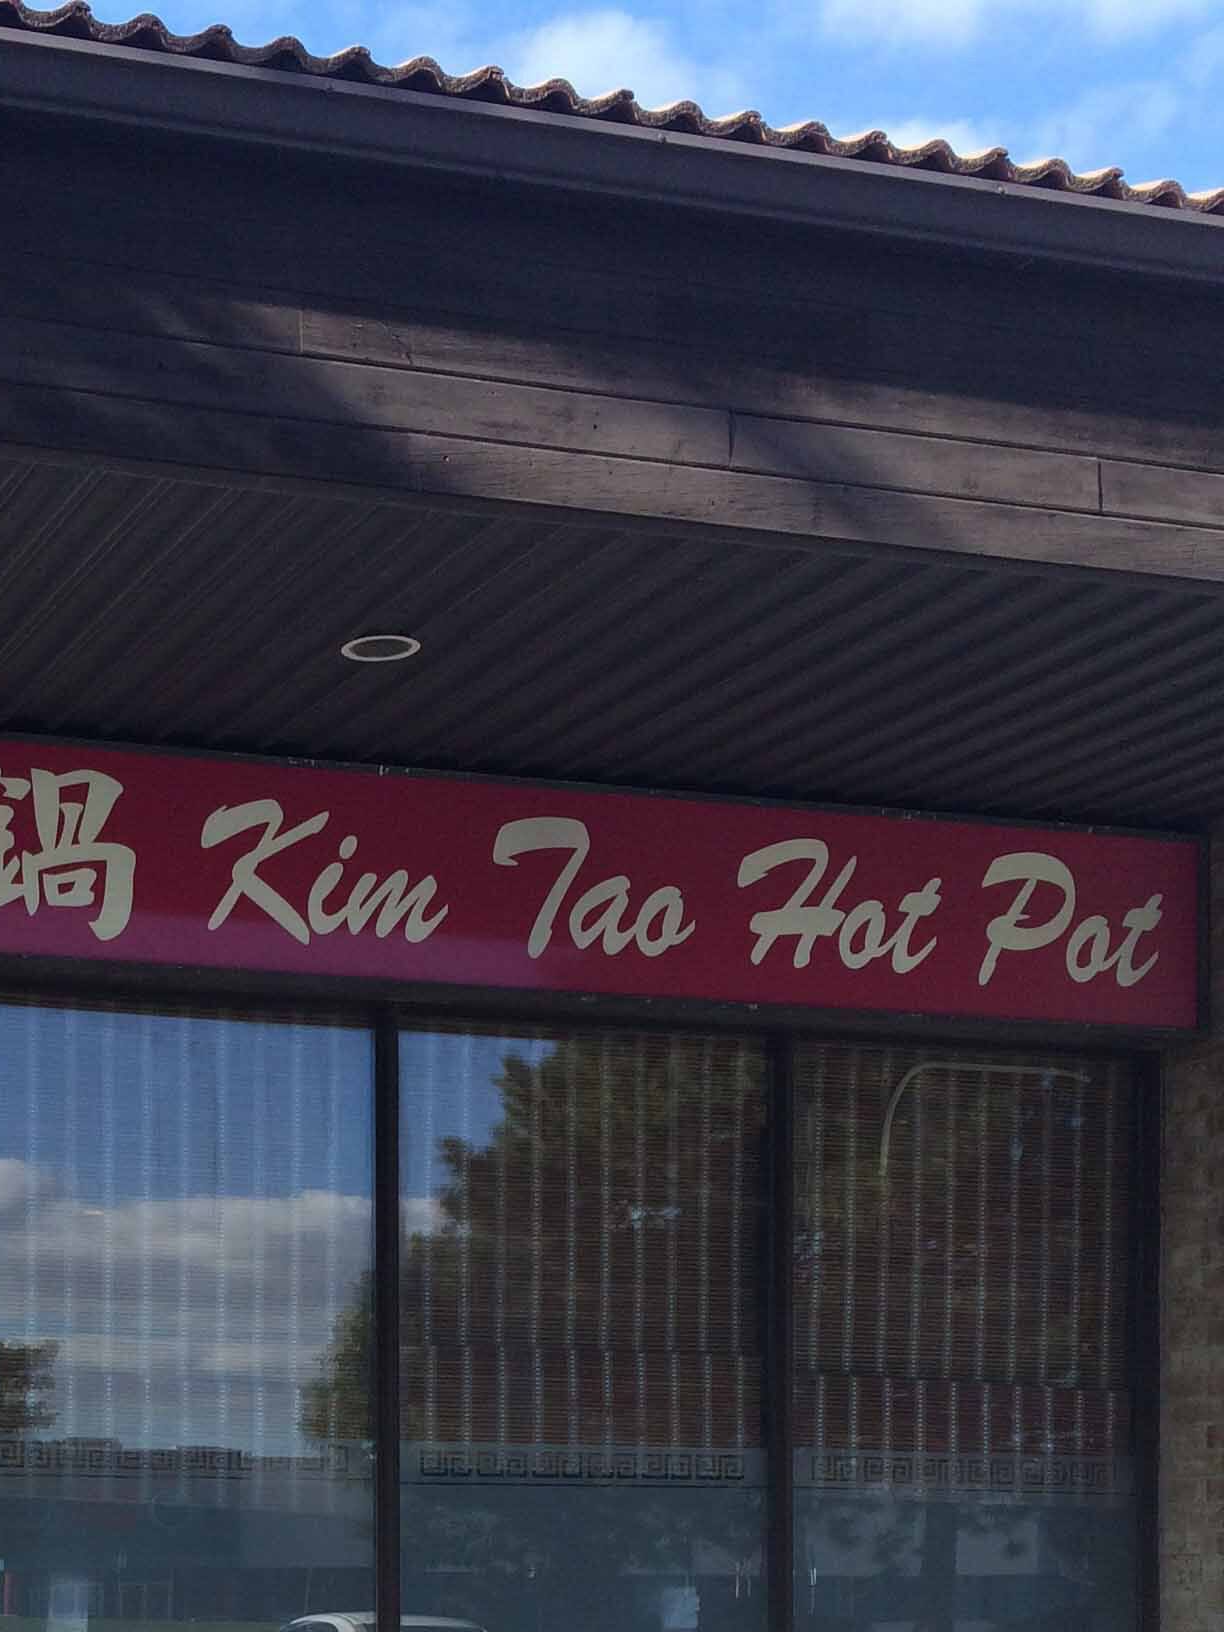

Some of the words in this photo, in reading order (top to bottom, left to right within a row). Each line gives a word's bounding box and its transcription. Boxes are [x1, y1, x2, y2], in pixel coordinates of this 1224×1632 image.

[200, 798, 449, 945] Kim
[492, 816, 696, 959] Tao
[736, 838, 942, 974] Hot
[978, 851, 1163, 987] Pot
